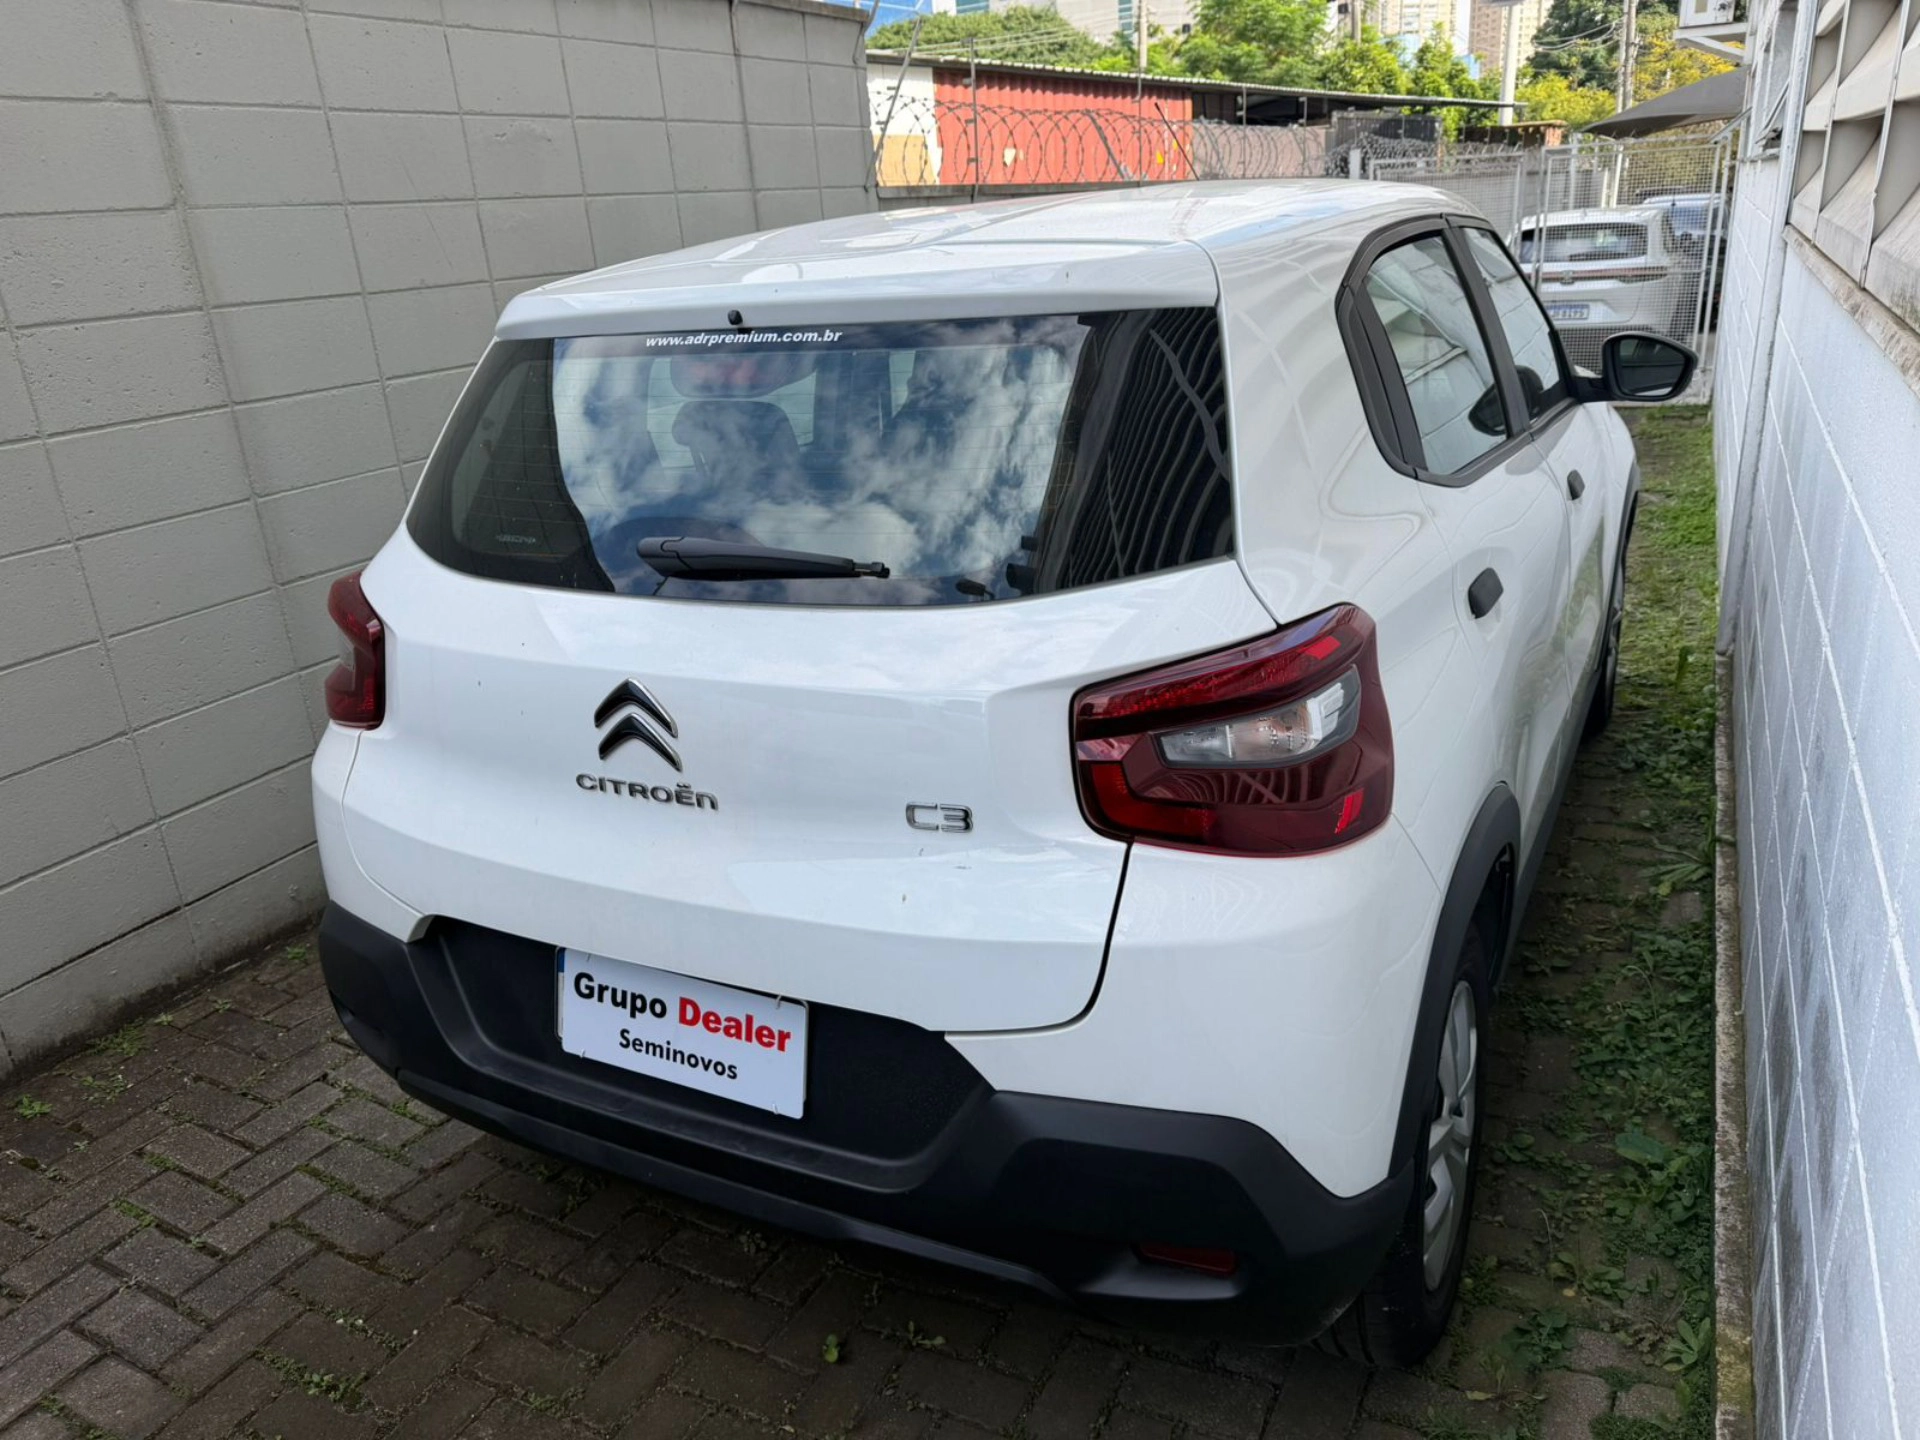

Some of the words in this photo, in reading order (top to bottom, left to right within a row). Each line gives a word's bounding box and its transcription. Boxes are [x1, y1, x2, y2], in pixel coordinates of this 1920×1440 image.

[646, 329, 843, 347] www.adrpremium.com.br
[905, 801, 973, 833] C3
[574, 971, 667, 1019] Grupo
[678, 996, 791, 1052] Dealer
[619, 1028, 738, 1080] Seminovos
